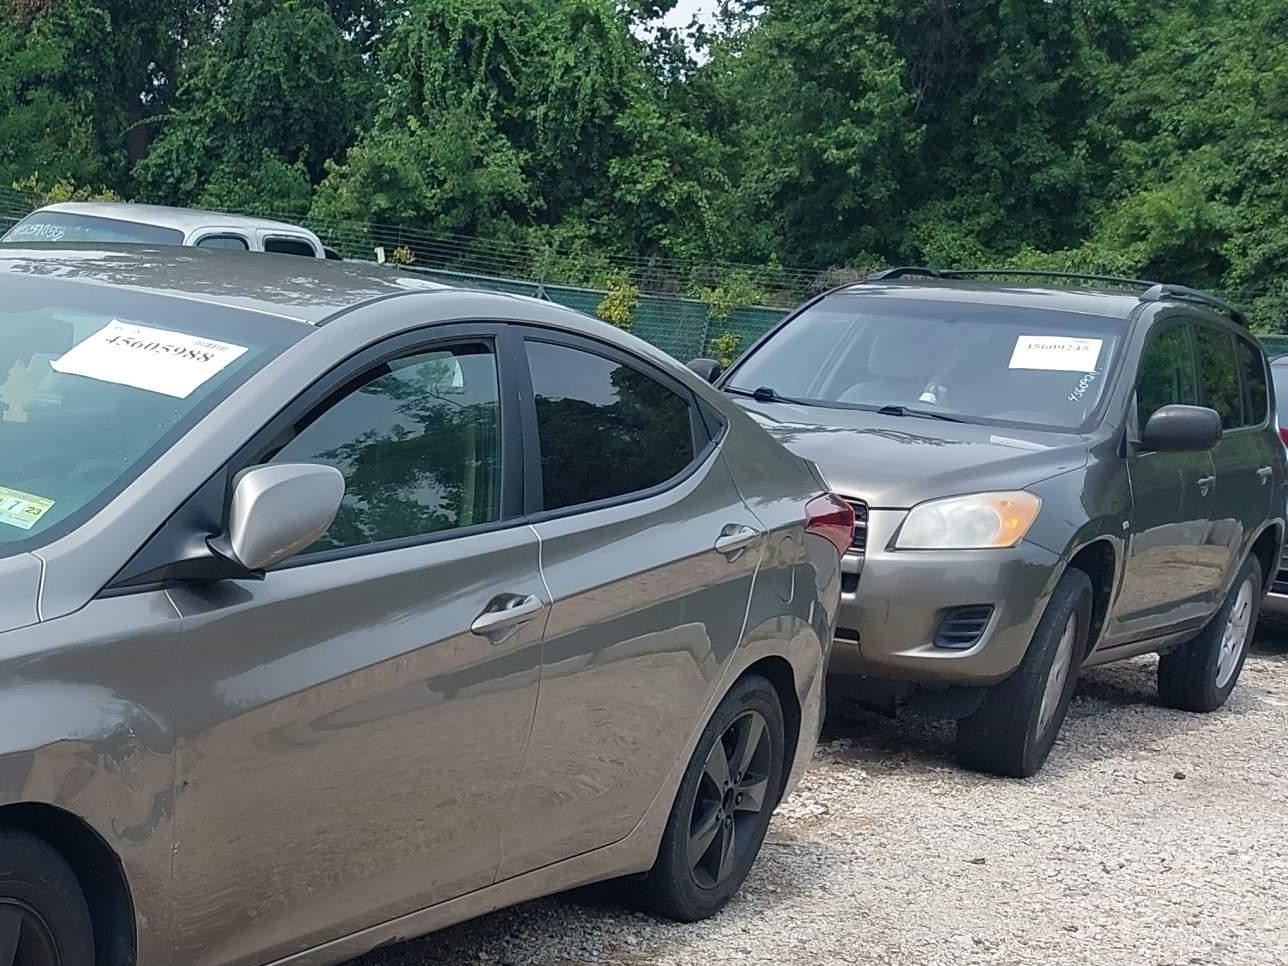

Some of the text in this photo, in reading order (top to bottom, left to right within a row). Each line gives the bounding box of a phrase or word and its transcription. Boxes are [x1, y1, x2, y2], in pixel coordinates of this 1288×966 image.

[106, 335, 215, 362] 45605988
[8, 500, 21, 511] 7
[25, 506, 43, 516] 23
